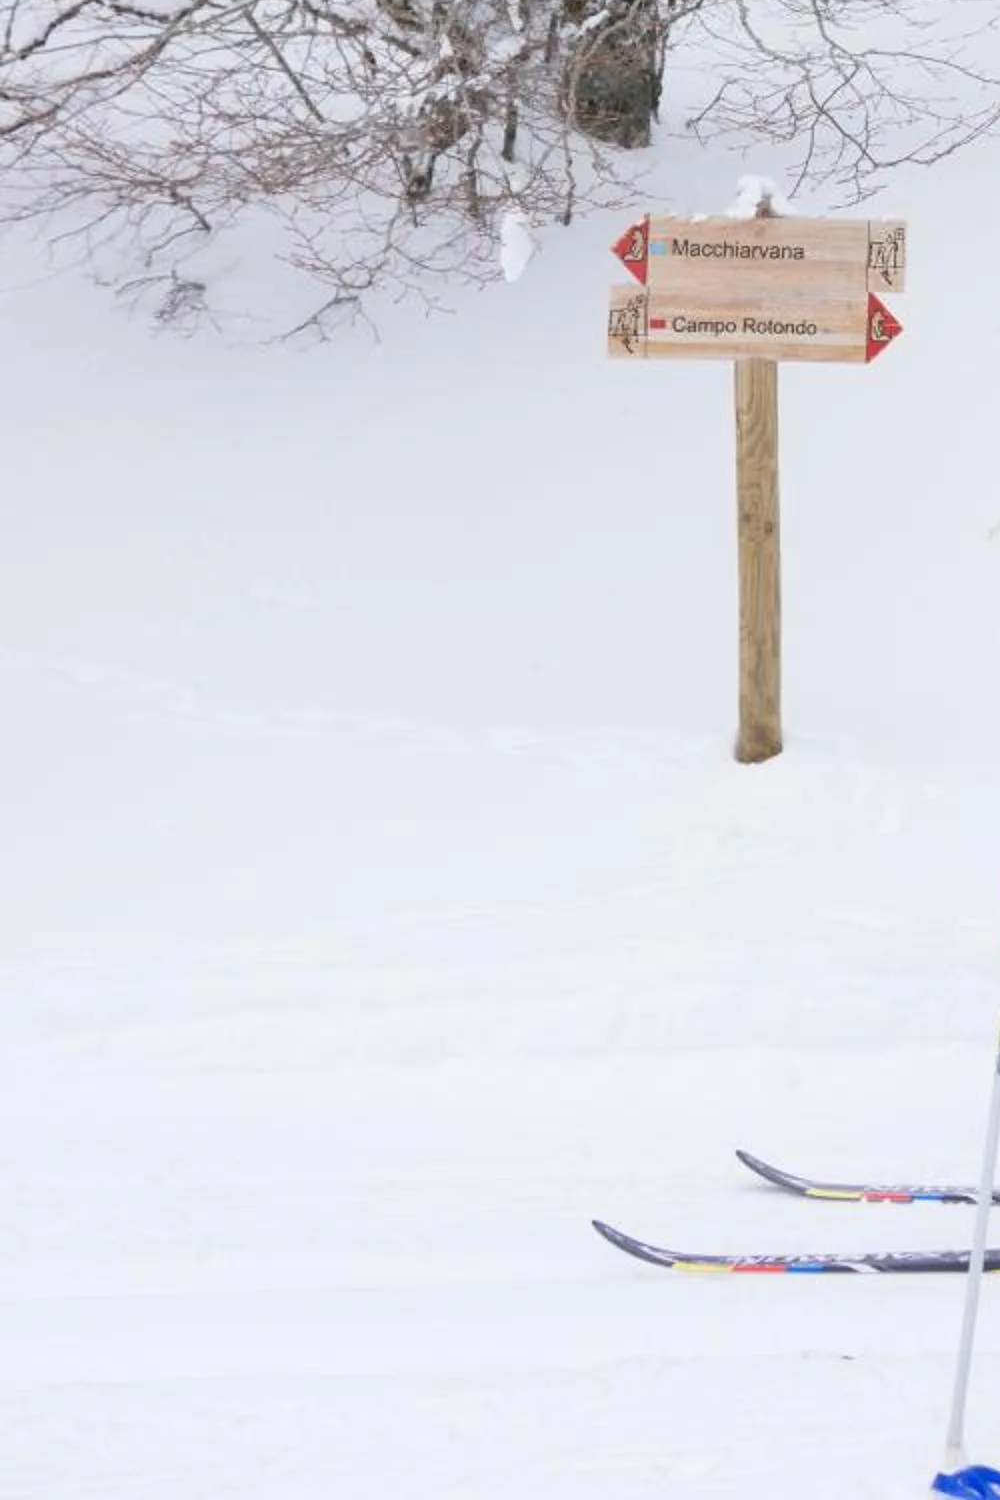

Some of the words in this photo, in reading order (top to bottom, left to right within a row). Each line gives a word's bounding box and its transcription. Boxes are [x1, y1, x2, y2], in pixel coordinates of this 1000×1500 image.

[671, 238, 805, 260] Macchiarvana
[672, 315, 737, 334] Campo
[743, 317, 818, 336] Rotondo
